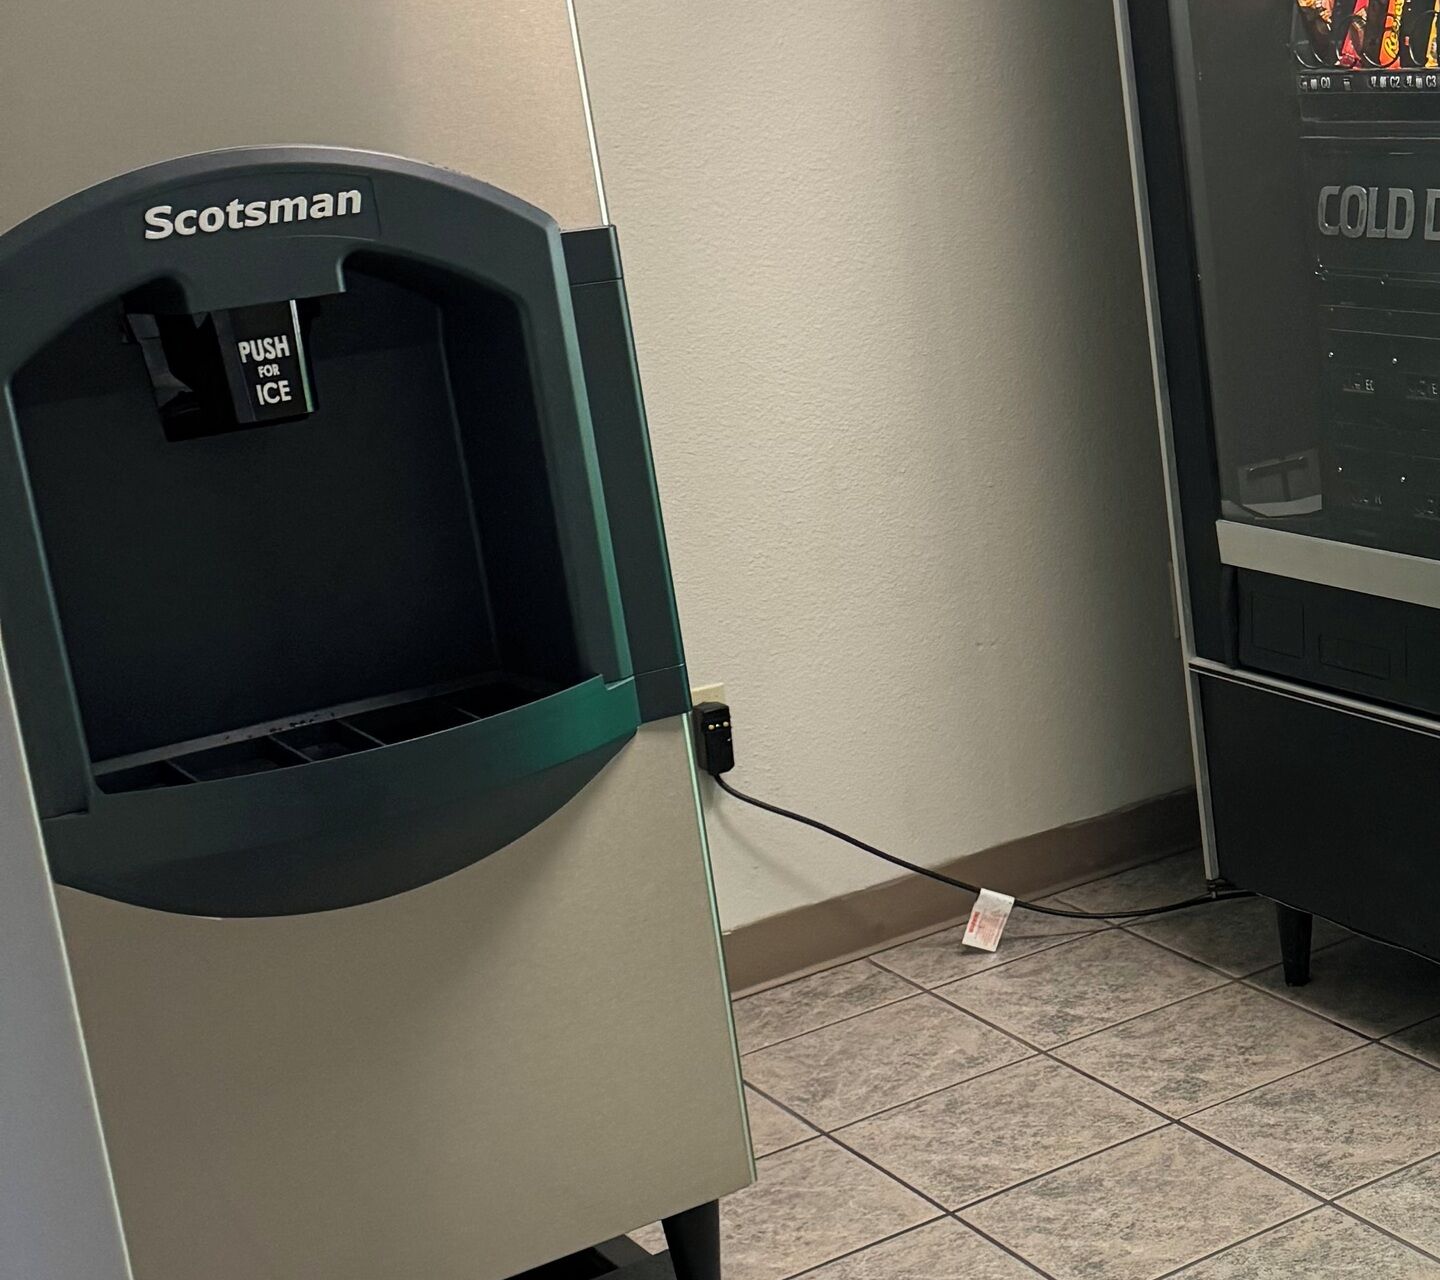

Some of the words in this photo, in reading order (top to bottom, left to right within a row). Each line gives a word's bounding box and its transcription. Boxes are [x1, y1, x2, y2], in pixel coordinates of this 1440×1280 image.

[1426, 75, 1436, 88] C3
[144, 189, 362, 240] Scotsman
[1317, 184, 1415, 239] COLD
[238, 334, 290, 364] PUSH
[258, 364, 280, 378] FOR
[256, 380, 292, 406] ICE
